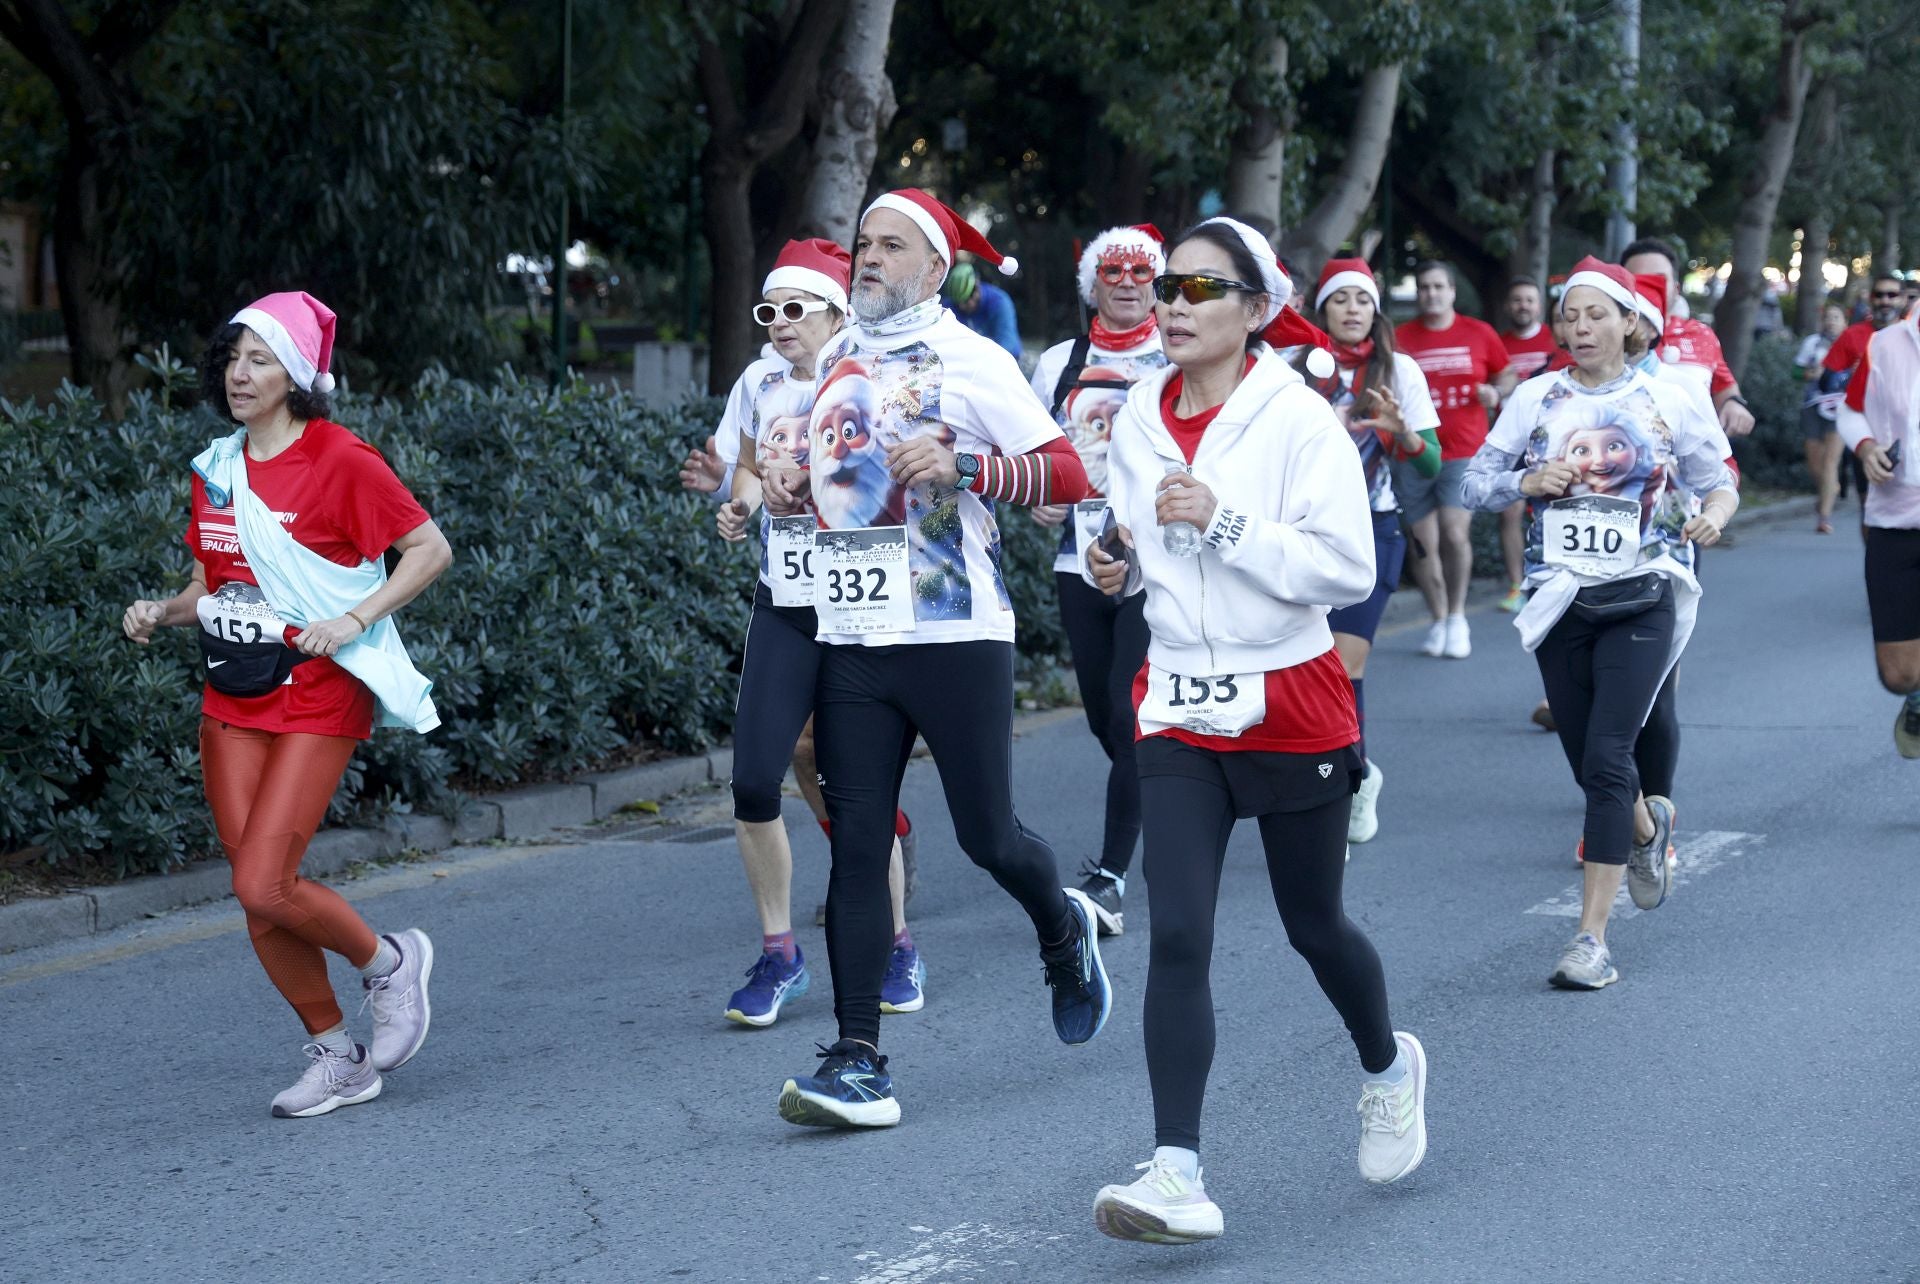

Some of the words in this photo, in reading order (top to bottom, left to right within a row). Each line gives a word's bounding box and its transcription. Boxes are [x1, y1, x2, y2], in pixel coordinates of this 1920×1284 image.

[1106, 243, 1144, 254] FELIZ
[207, 541, 240, 554] PALMA
[871, 542, 905, 550] XIV
[1563, 524, 1623, 553] 310
[828, 568, 889, 603] 332
[213, 617, 263, 643] 152
[1169, 674, 1238, 706] 153
